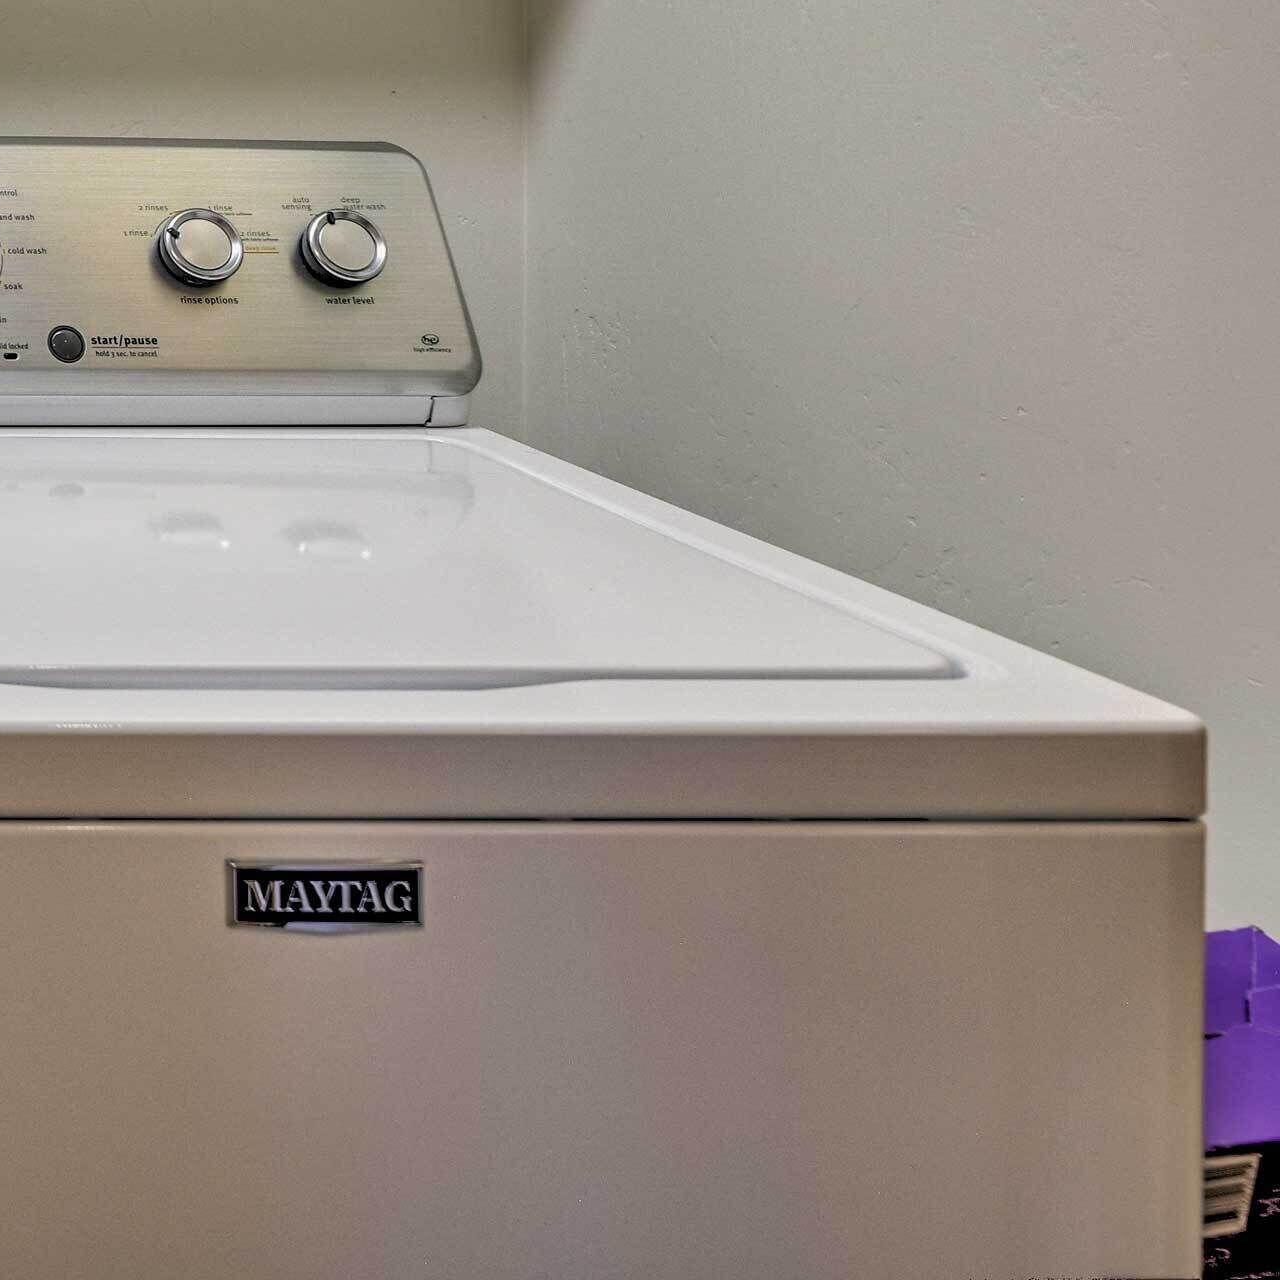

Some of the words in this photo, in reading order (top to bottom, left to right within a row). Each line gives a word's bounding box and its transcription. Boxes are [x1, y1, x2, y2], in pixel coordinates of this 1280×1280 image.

[7, 247, 25, 255] cold
[26, 247, 47, 255] wash
[4, 282, 23, 290] soak
[180, 296, 203, 304] rinse
[205, 296, 239, 305] options
[325, 297, 351, 305] water
[352, 296, 375, 305] level
[91, 334, 158, 348] start/pause
[8, 342, 29, 350] locked
[243, 879, 413, 913] MAYTAG
